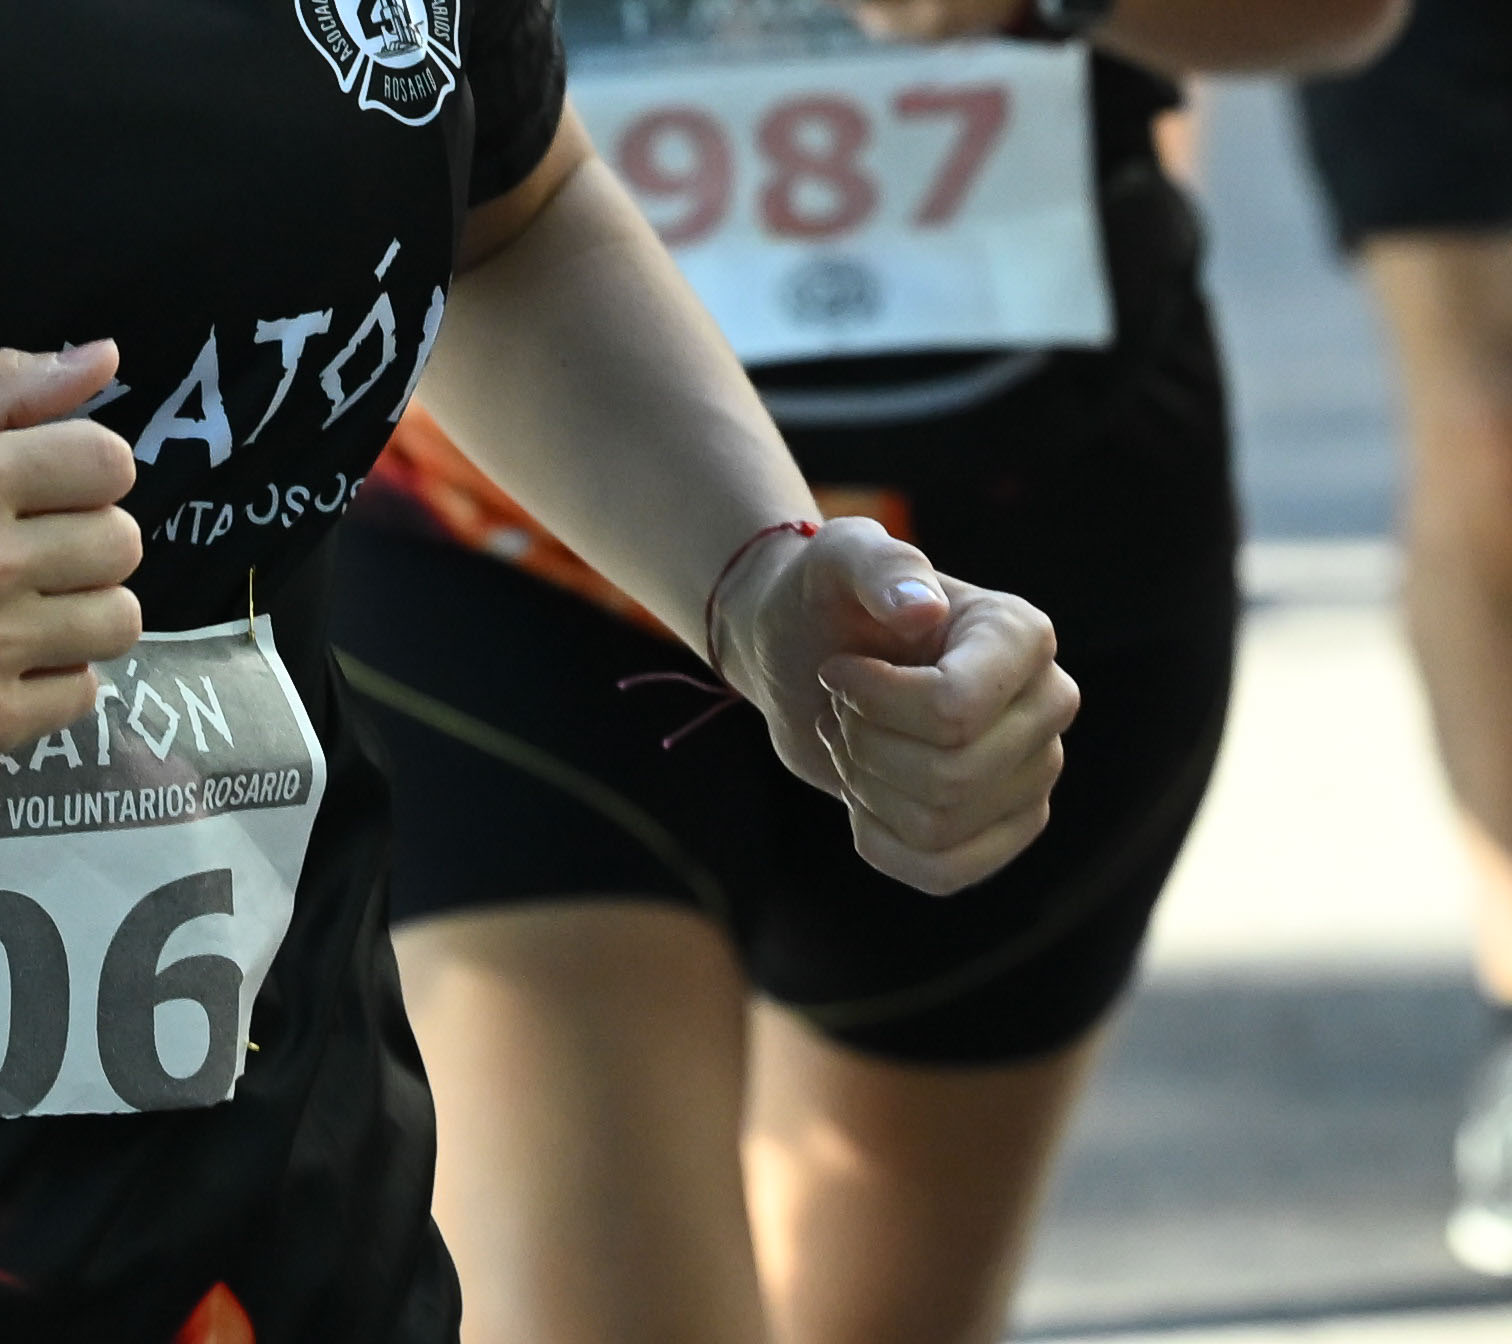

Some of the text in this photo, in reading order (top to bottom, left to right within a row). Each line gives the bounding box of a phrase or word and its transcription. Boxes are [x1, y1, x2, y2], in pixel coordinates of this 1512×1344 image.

[383, 66, 438, 103] ROSARIO
[610, 79, 1016, 250] 987
[6, 782, 198, 831] VOLUNTARIOS
[202, 768, 302, 812] ROSARIO
